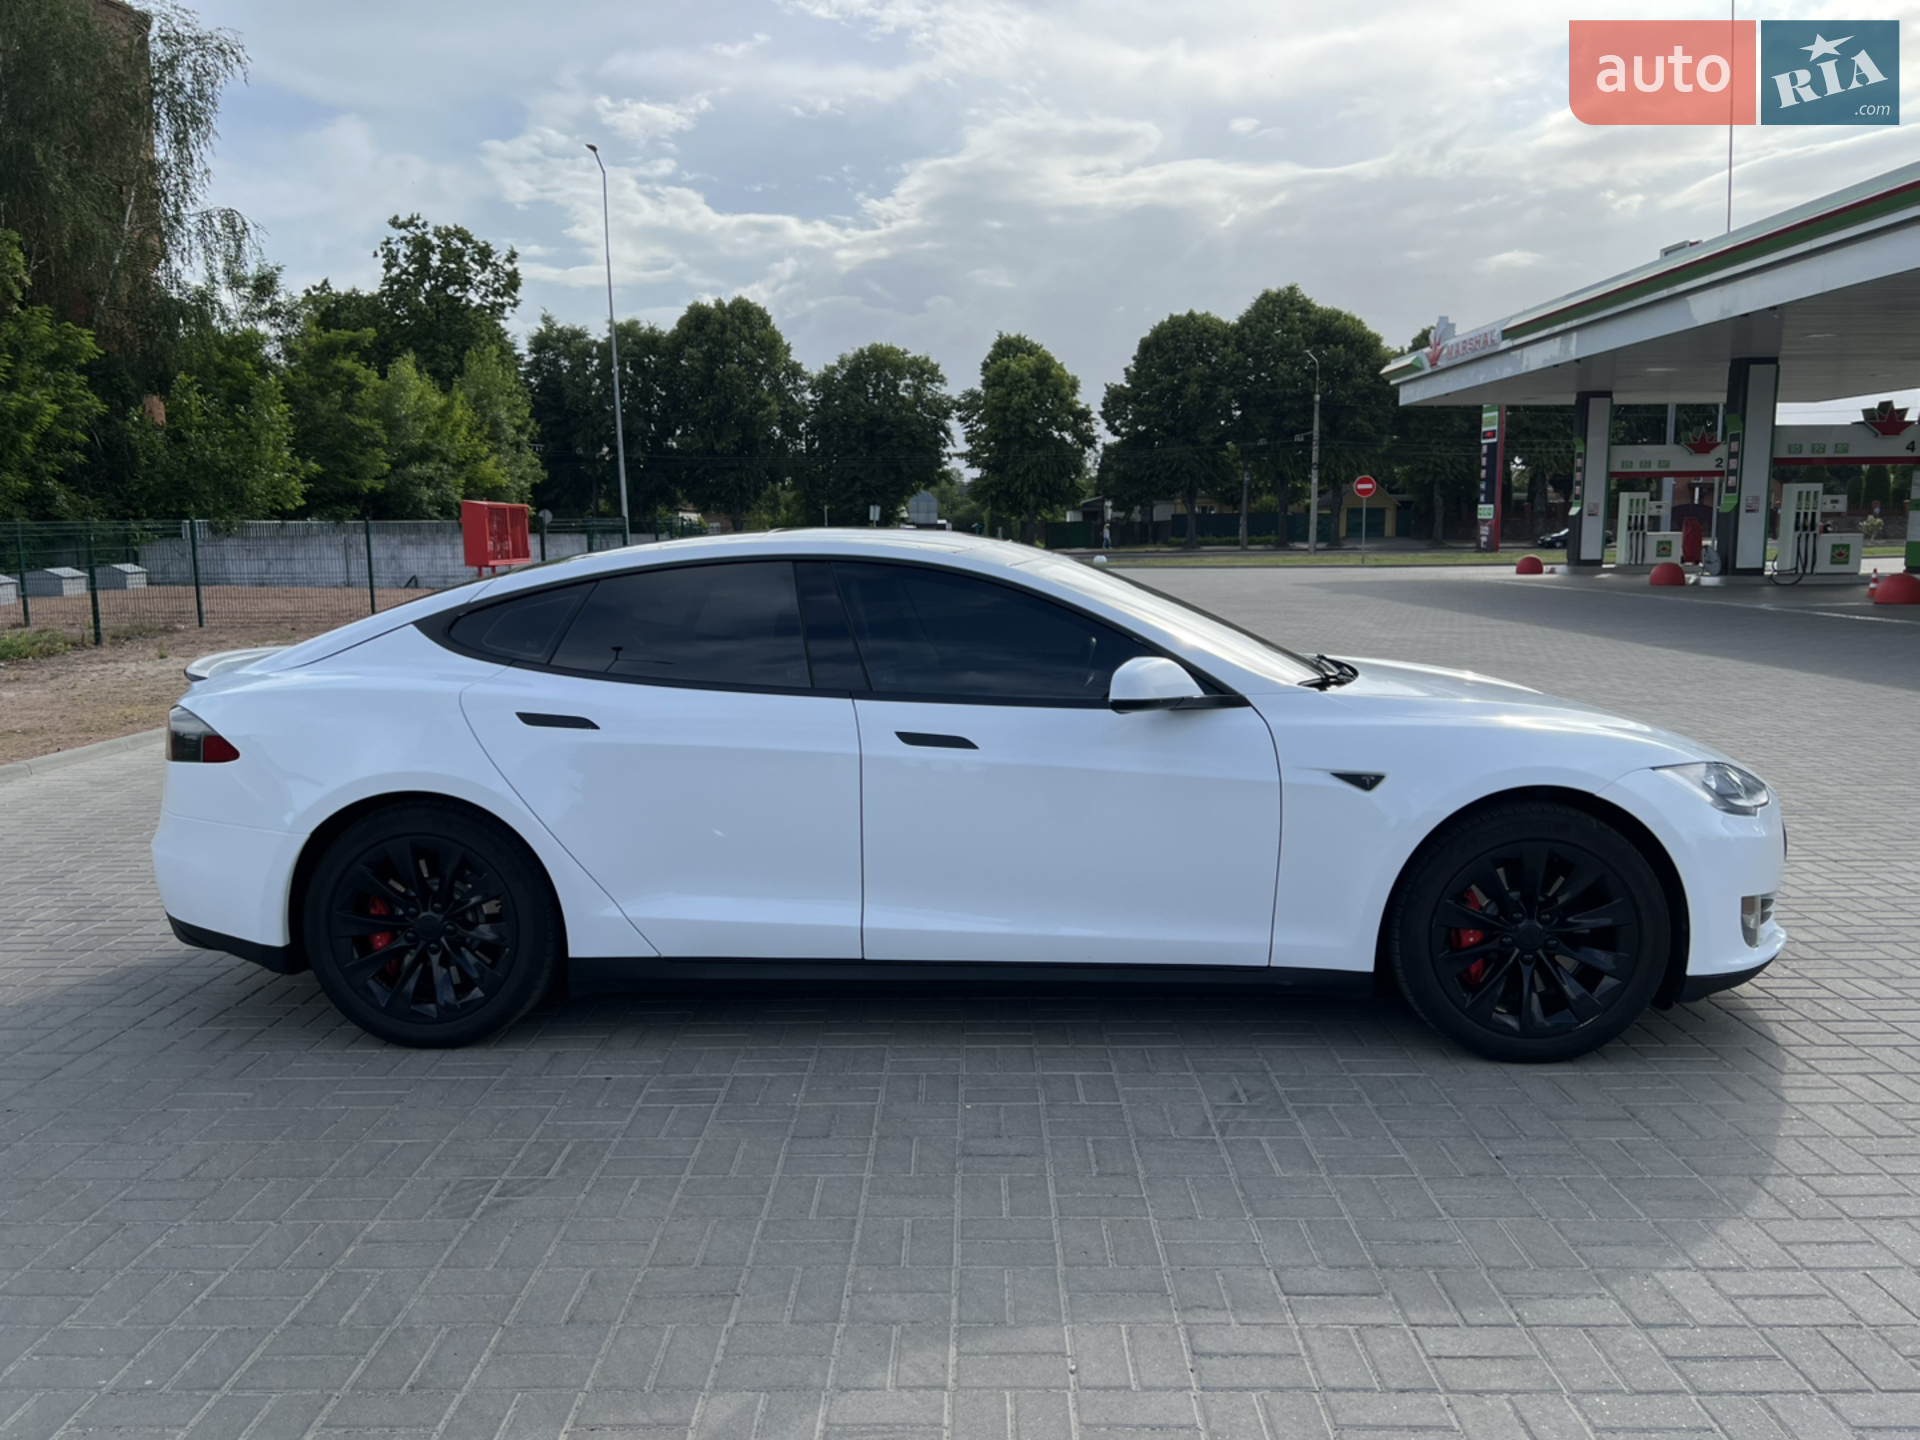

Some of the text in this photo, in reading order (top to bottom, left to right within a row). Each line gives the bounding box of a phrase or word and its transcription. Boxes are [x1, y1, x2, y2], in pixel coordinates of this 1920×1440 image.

[1447, 329, 1497, 360] MARSHAL
[1905, 440, 1916, 453] 4
[1715, 457, 1724, 468] 2
